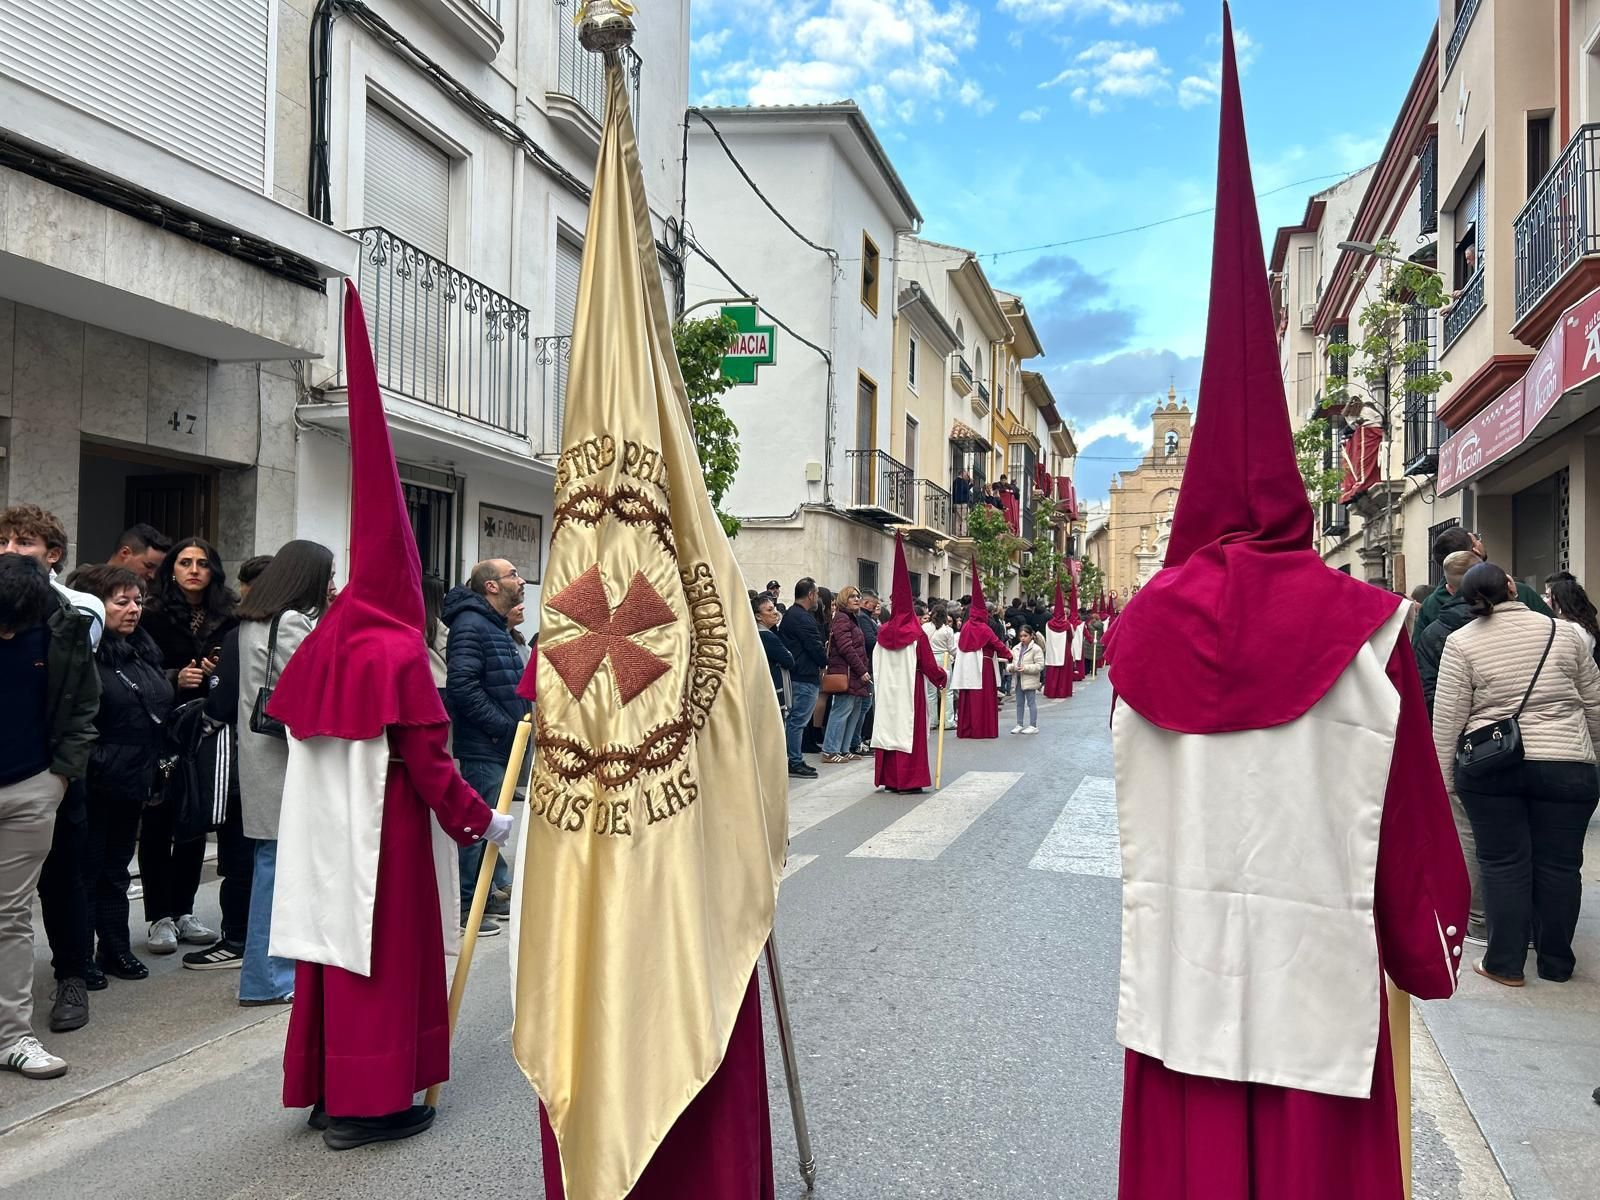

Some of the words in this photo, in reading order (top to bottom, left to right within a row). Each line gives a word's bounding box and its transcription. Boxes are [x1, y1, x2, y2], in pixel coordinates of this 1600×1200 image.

[729, 335, 766, 354] MACIA
[168, 411, 197, 434] 47
[556, 435, 615, 488] STRO
[498, 520, 536, 543] FARMACIA
[681, 562, 728, 730] CESIDADES
[530, 781, 592, 831] SÚS
[593, 799, 632, 836] DE
[645, 768, 698, 825] LAS
